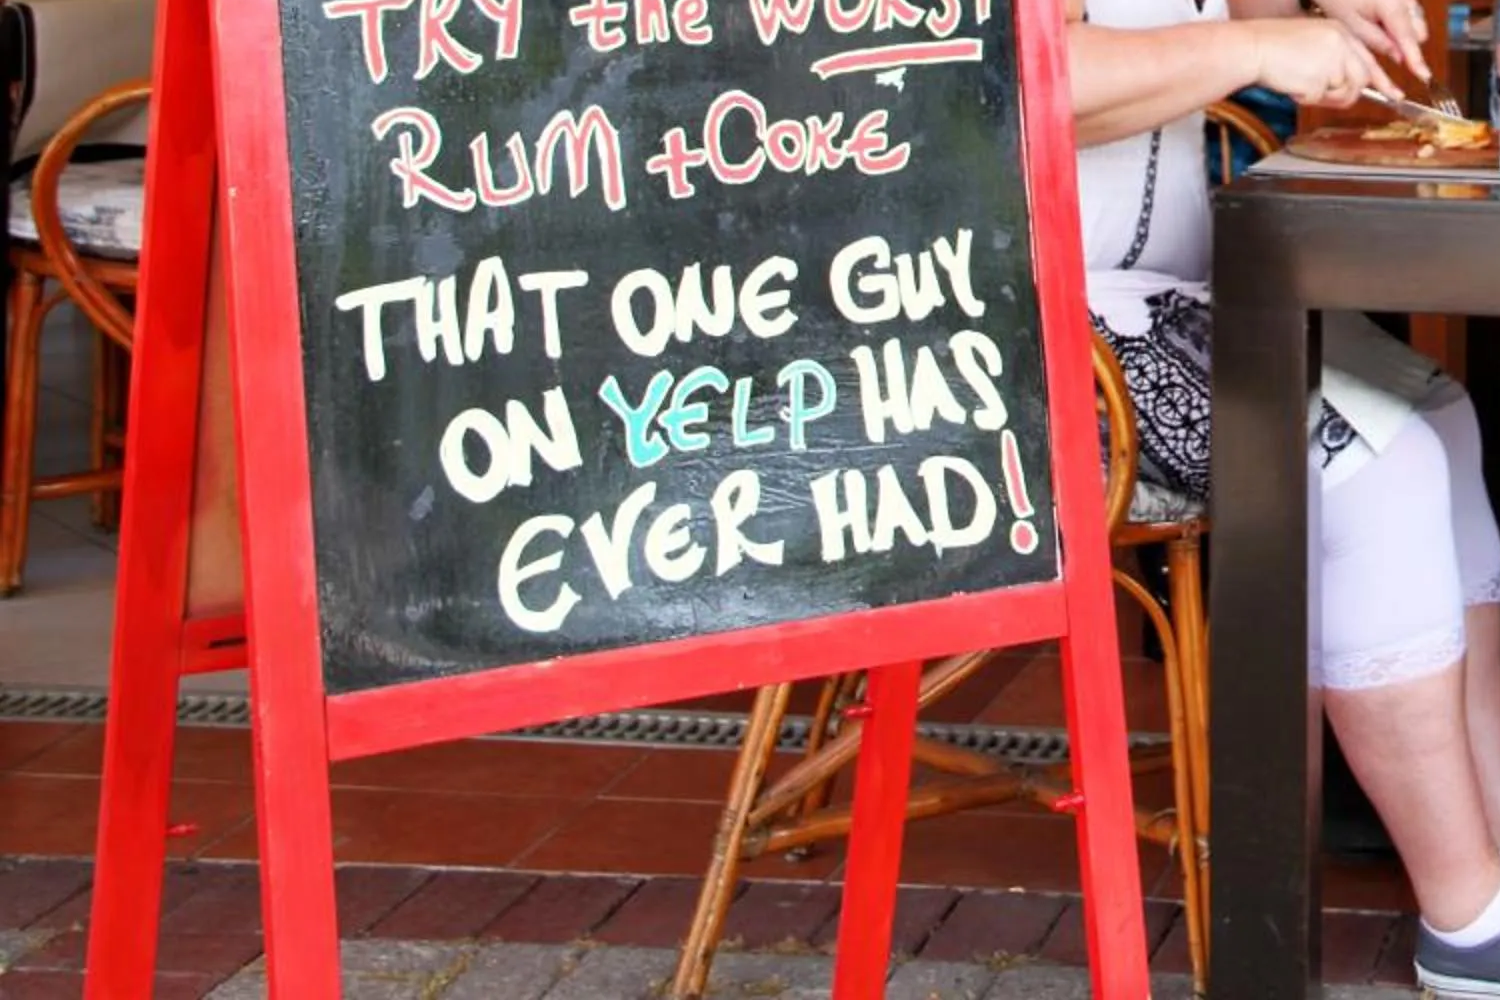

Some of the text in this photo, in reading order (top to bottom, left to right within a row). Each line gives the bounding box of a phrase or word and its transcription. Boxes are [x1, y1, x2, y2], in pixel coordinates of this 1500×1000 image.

[370, 105, 627, 212] RUM
[336, 228, 986, 382] THAT ONE GUY
[439, 330, 1008, 503] ON YELP HAS
[498, 430, 1039, 633] EVER HAD!
